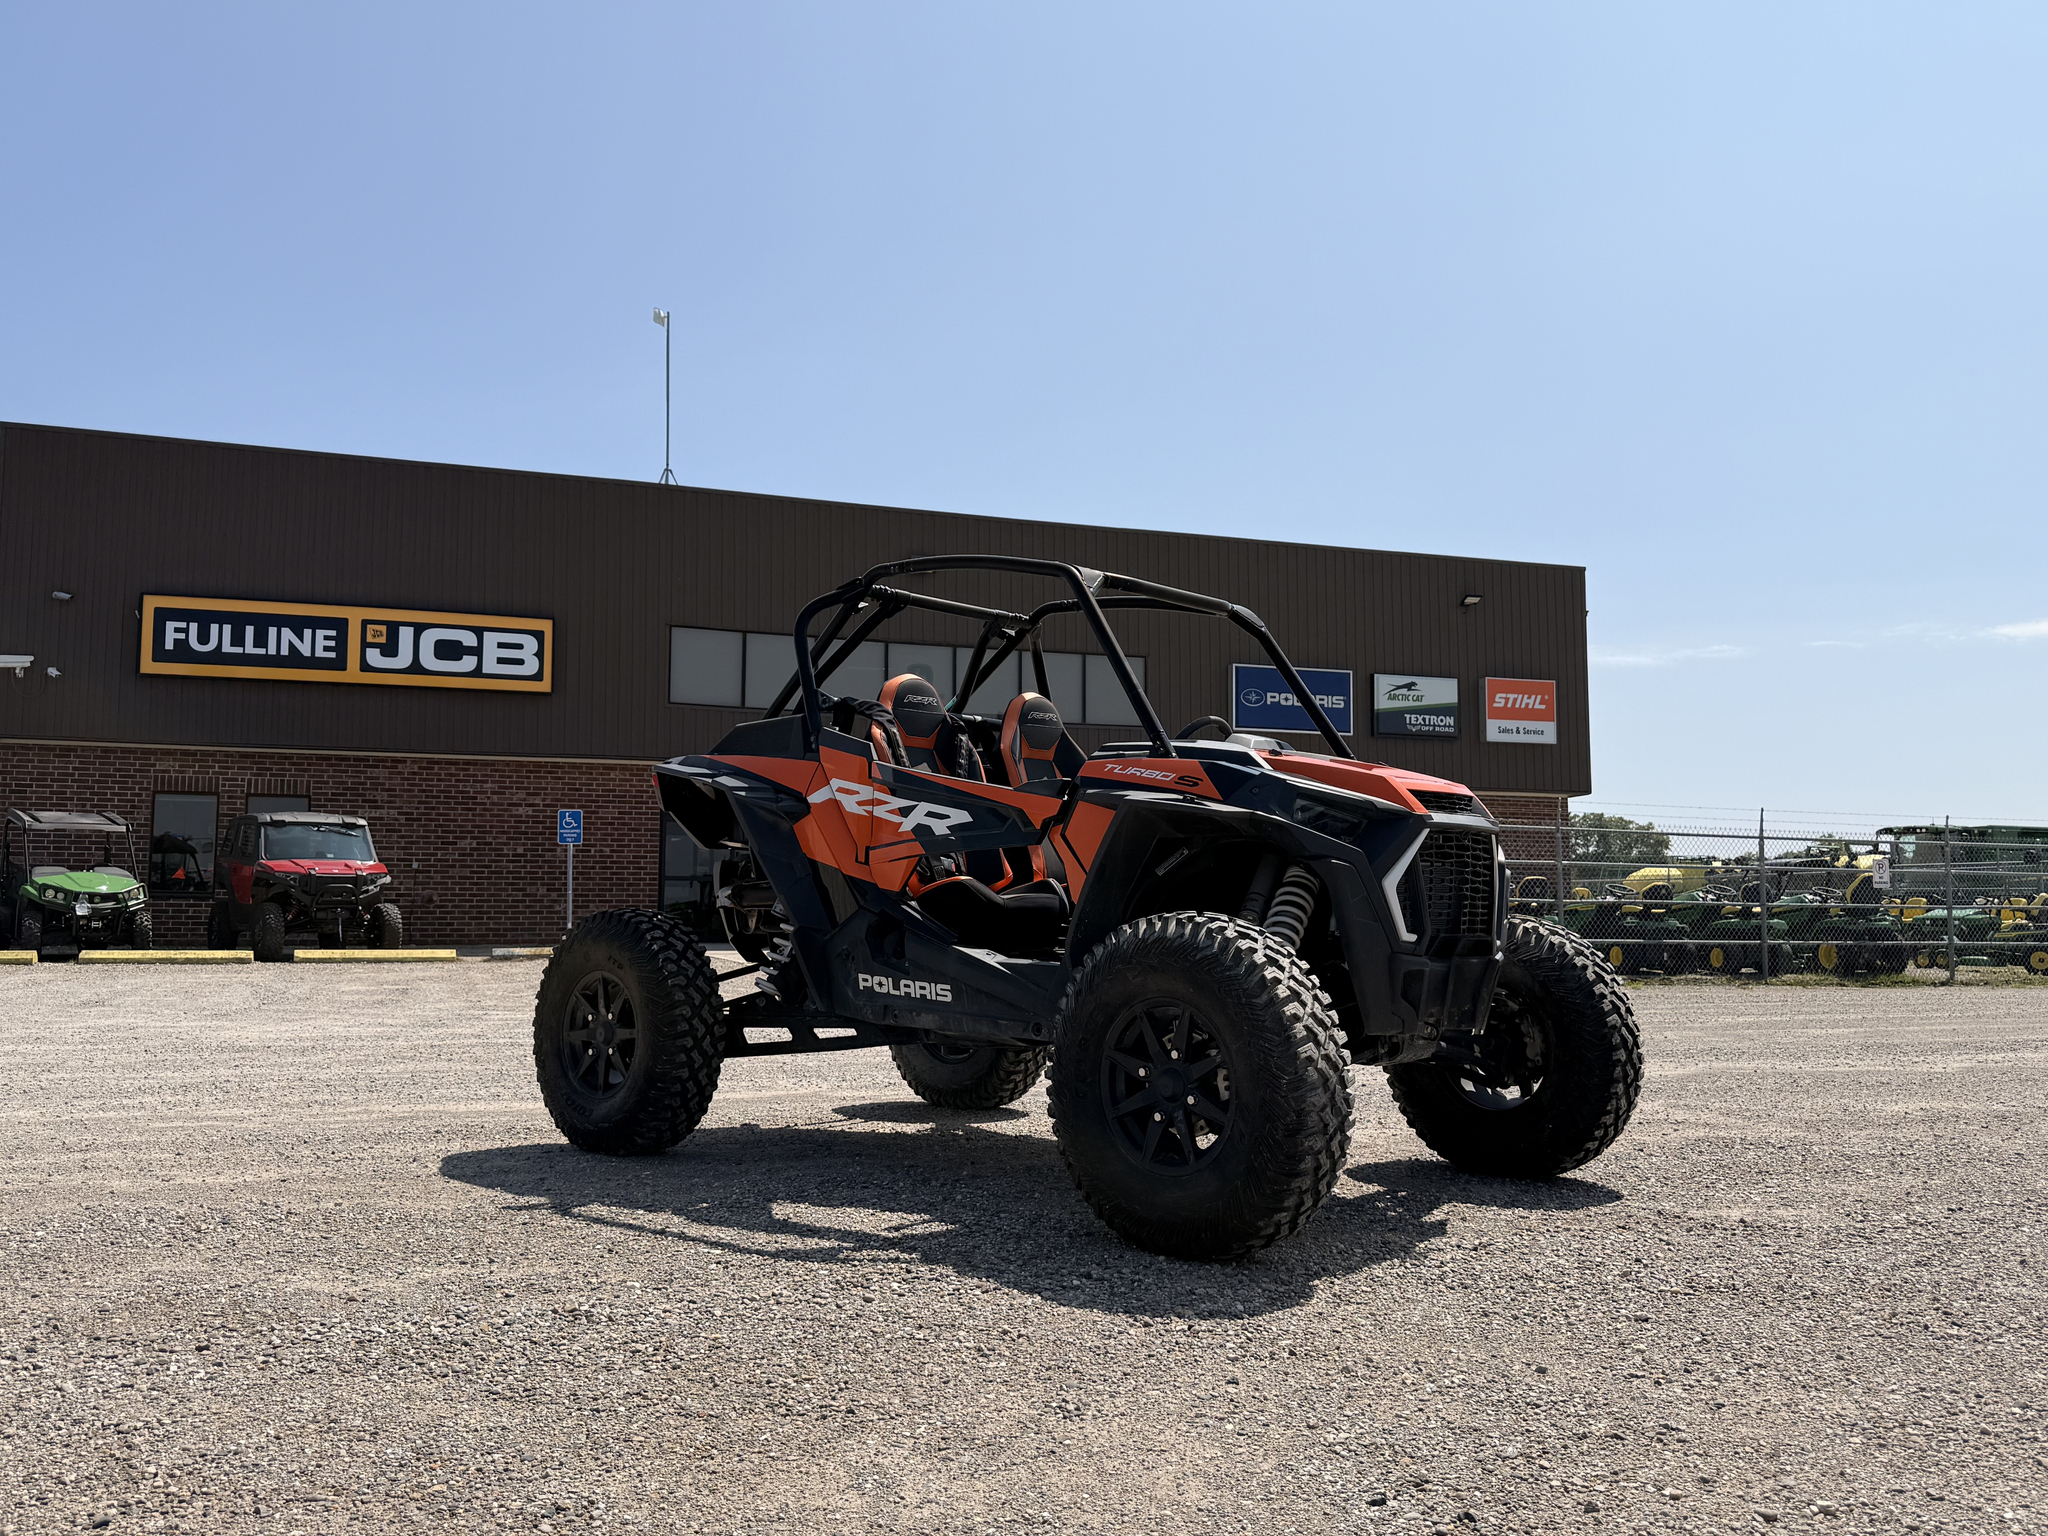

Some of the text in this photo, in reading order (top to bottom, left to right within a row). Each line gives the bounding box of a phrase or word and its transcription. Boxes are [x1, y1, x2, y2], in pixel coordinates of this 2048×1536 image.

[165, 620, 337, 658] FULLINE
[366, 625, 540, 676] JCB
[903, 694, 938, 706] RZR
[1266, 692, 1345, 708] POLRIS
[1387, 693, 1425, 702] ARCTIC CAT
[1492, 693, 1546, 709] STIHL
[1027, 711, 1058, 722] RZR
[1404, 714, 1454, 726] TEXTRON
[1497, 725, 1545, 736] Sales & Service
[1104, 763, 1204, 788] TURBO S
[806, 778, 974, 837] RZR
[607, 955, 624, 970] ITP
[858, 973, 953, 1002] POLARIS
